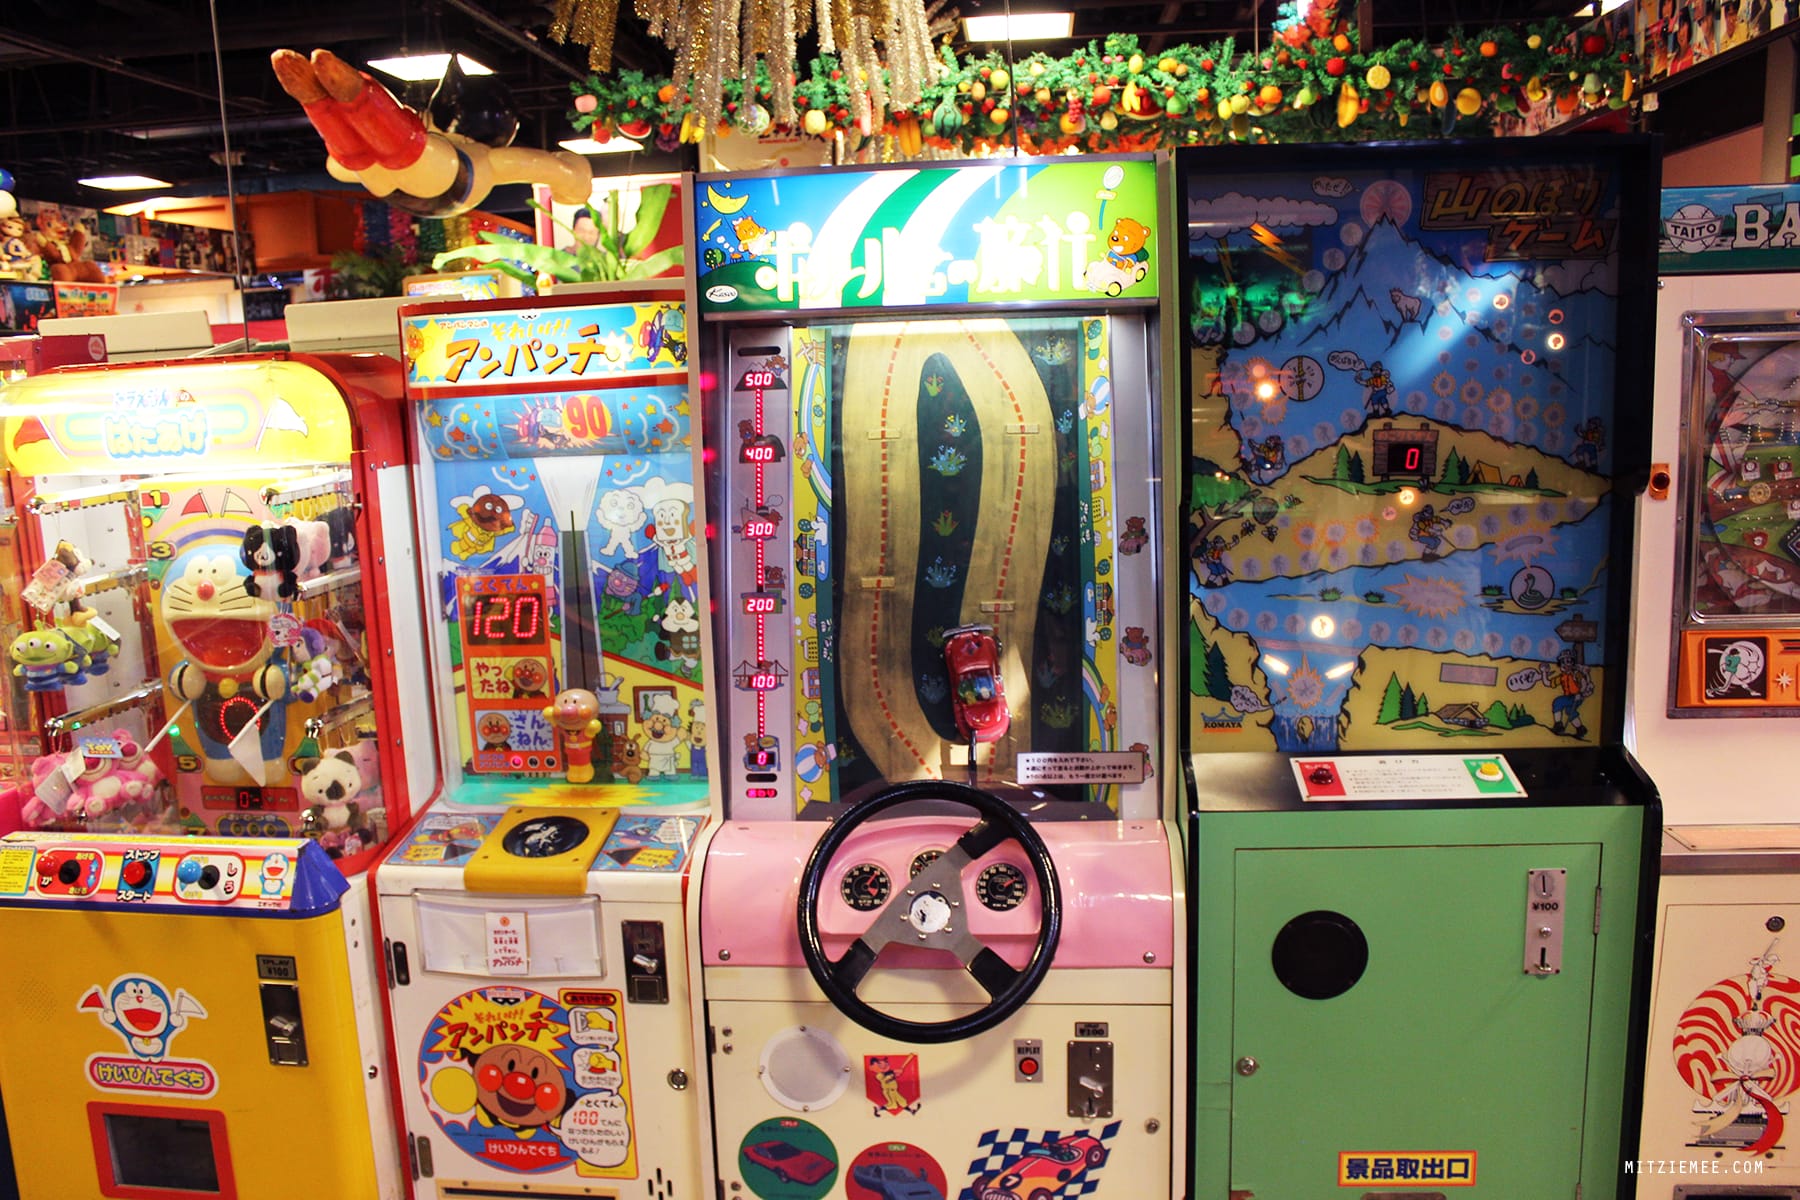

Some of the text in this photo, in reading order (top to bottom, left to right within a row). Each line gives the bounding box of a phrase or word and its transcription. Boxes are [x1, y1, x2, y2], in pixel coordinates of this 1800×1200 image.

[1429, 175, 1602, 221] 山のぼり
[1502, 220, 1605, 251] ゲーム
[1671, 223, 1717, 238] TAITO
[445, 324, 606, 383] アンパンチ
[745, 373, 773, 386] 500
[565, 396, 609, 438] 90
[745, 447, 773, 460] 400
[1405, 448, 1419, 469] 0
[149, 489, 162, 508] 1
[747, 523, 774, 536] 300
[151, 541, 171, 559] 3
[474, 578, 528, 592] とくてん
[747, 599, 774, 611] 200
[473, 596, 540, 638] 120
[751, 675, 776, 688] 100
[1203, 721, 1243, 729] KOMAYA
[178, 754, 198, 772] 5
[757, 753, 767, 765] 0
[239, 791, 249, 808] 0
[125, 849, 160, 861] ストップ
[116, 889, 151, 903] スタート
[1531, 902, 1559, 911] ¥100
[447, 1010, 549, 1049] アンパンチ
[1017, 1047, 1040, 1055] REPLAY
[573, 1110, 599, 1126] 100
[1345, 1158, 1471, 1180] 景品取出口
[1006, 1174, 1019, 1187] 7
